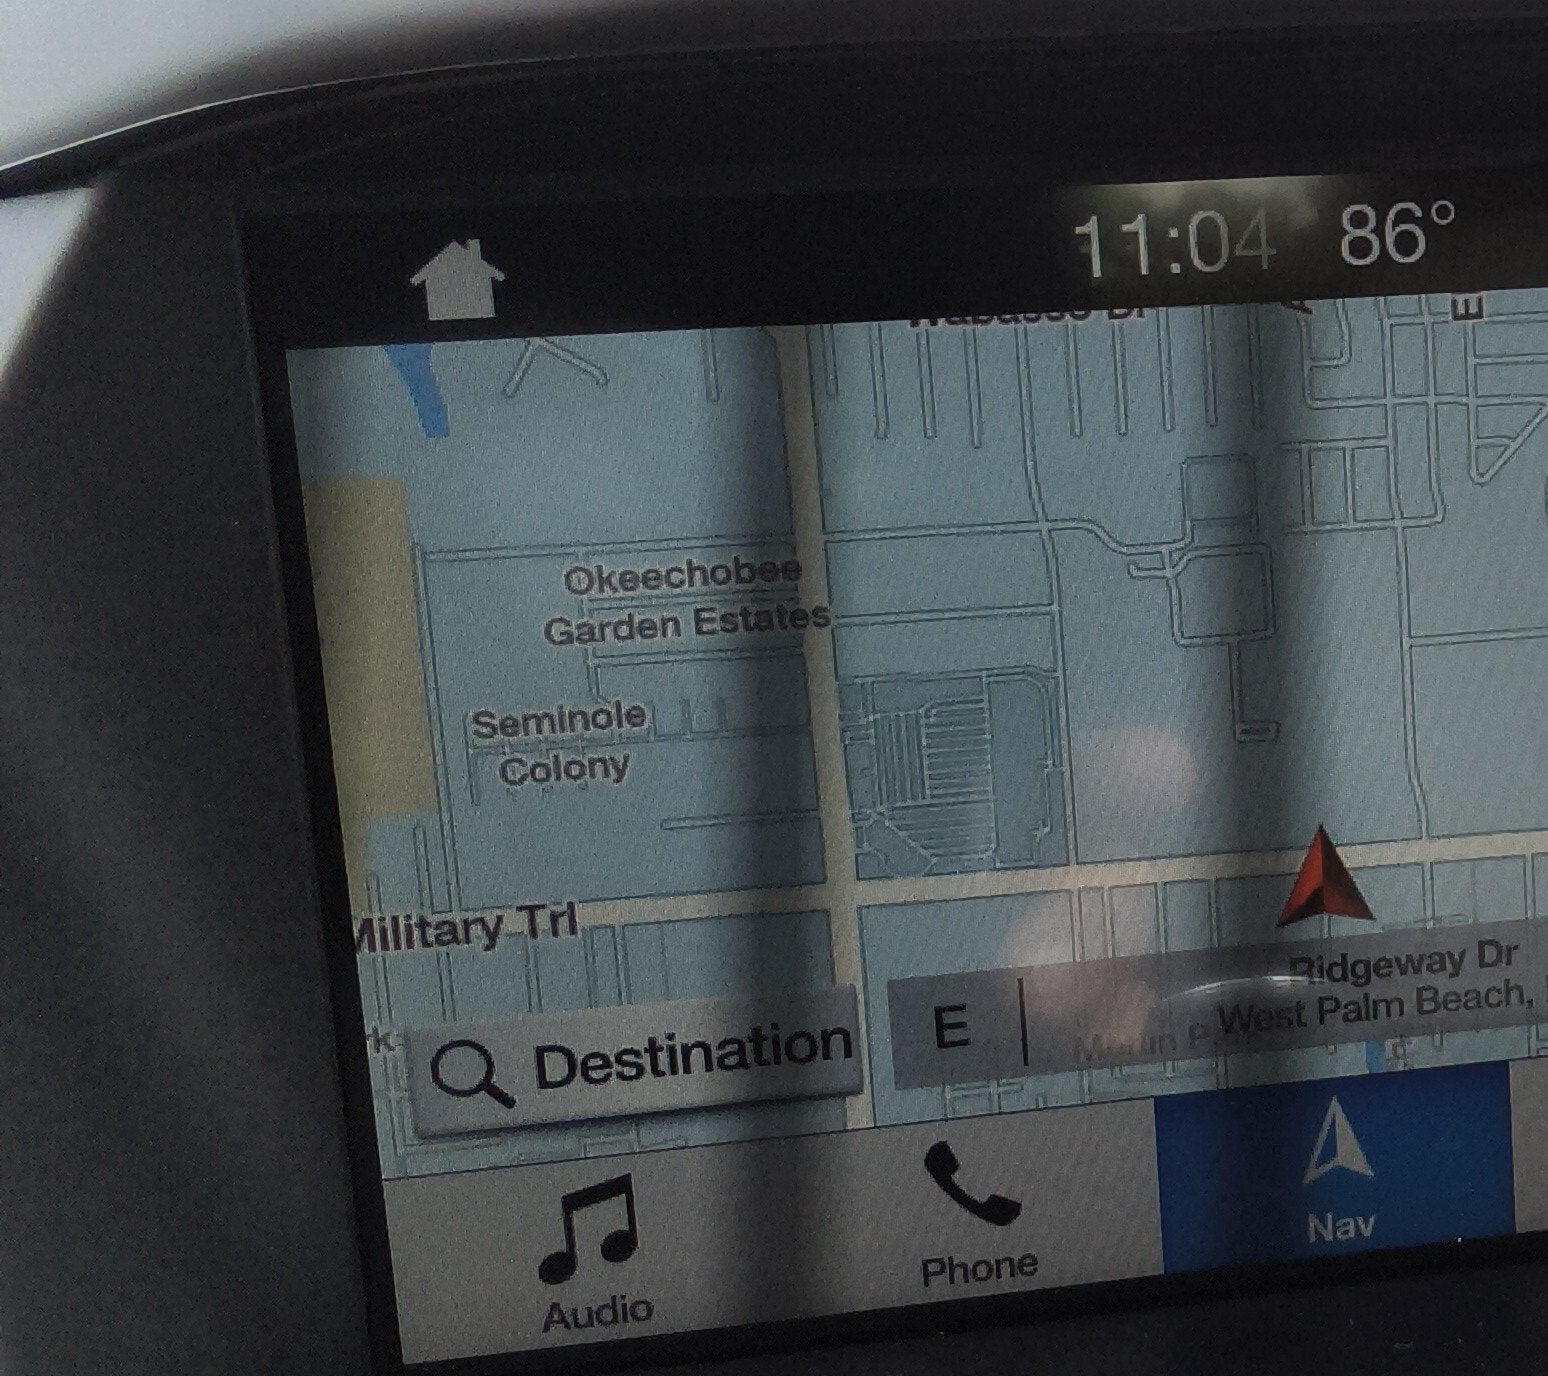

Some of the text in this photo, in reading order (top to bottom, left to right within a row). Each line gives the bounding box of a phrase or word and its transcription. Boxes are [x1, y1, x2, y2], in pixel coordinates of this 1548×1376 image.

[1075, 209, 1278, 280] 11:04
[564, 554, 803, 596] Okeechobee
[544, 601, 832, 646] Garden Estates
[472, 700, 648, 741] Seminole
[499, 752, 631, 787] Colony
[516, 900, 579, 941] Trl
[1289, 938, 1520, 988] Ridgeway Dr
[934, 1004, 971, 1049] E
[1217, 999, 1308, 1038] West
[1317, 990, 1405, 1027] Palm
[1416, 979, 1535, 1015] Beach,
[534, 1019, 856, 1092] Destination
[1307, 1211, 1376, 1244] Nav
[921, 1250, 1040, 1288] Phone
[542, 1293, 655, 1333] Audio
